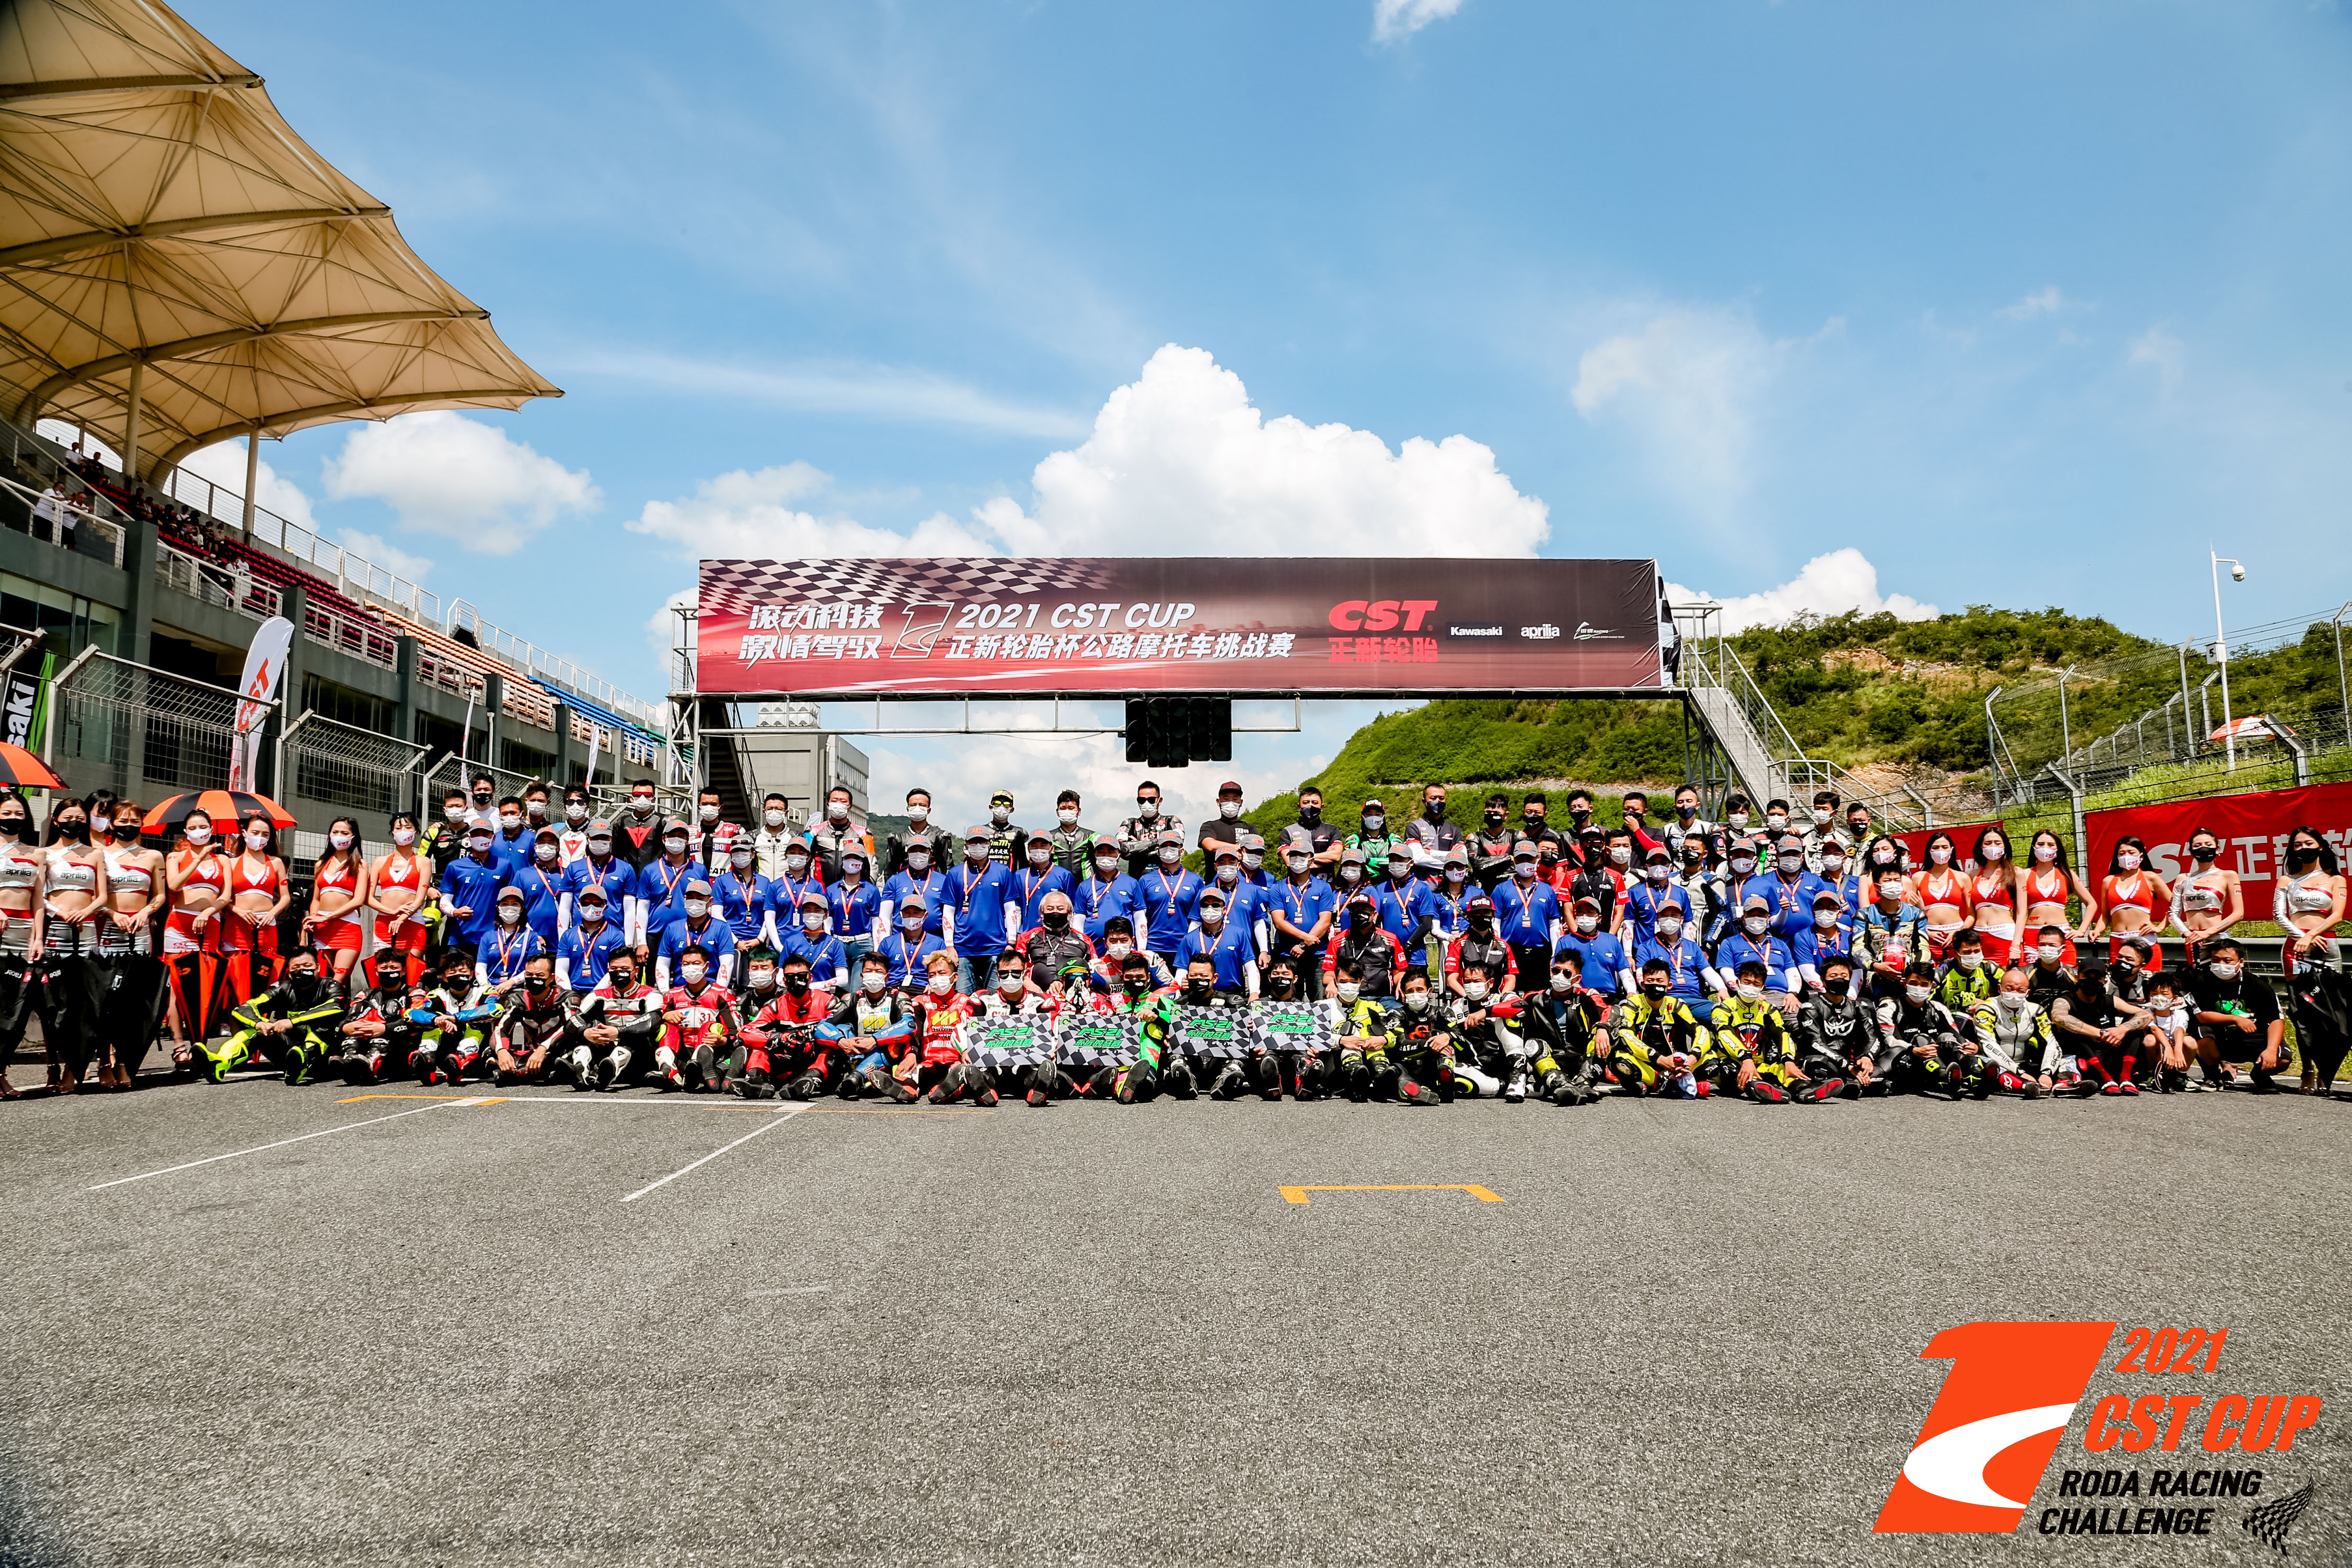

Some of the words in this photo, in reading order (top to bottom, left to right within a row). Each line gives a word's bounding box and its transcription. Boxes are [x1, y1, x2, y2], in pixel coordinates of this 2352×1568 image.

[748, 604, 884, 631] 滚动科技
[955, 603, 1041, 628] 2021
[1050, 603, 1122, 628] CST
[1124, 603, 1196, 628] CUP
[1329, 599, 1438, 631] CST
[1450, 626, 1503, 636] Kawasaki
[1520, 623, 1560, 639] aprilia
[737, 633, 883, 663] 激情驾驭
[945, 633, 1295, 660] 正新轮胎杯公路摩托车挑战赛
[1329, 637, 1438, 663] 正新轮胎
[6, 868, 32, 877] aprilia
[61, 871, 87, 879] aprilia
[111, 875, 139, 884] aprilia
[1712, 917, 1727, 940] BERIK
[700, 1012, 711, 1022] 31
[1986, 1044, 2012, 1066] BERIK
